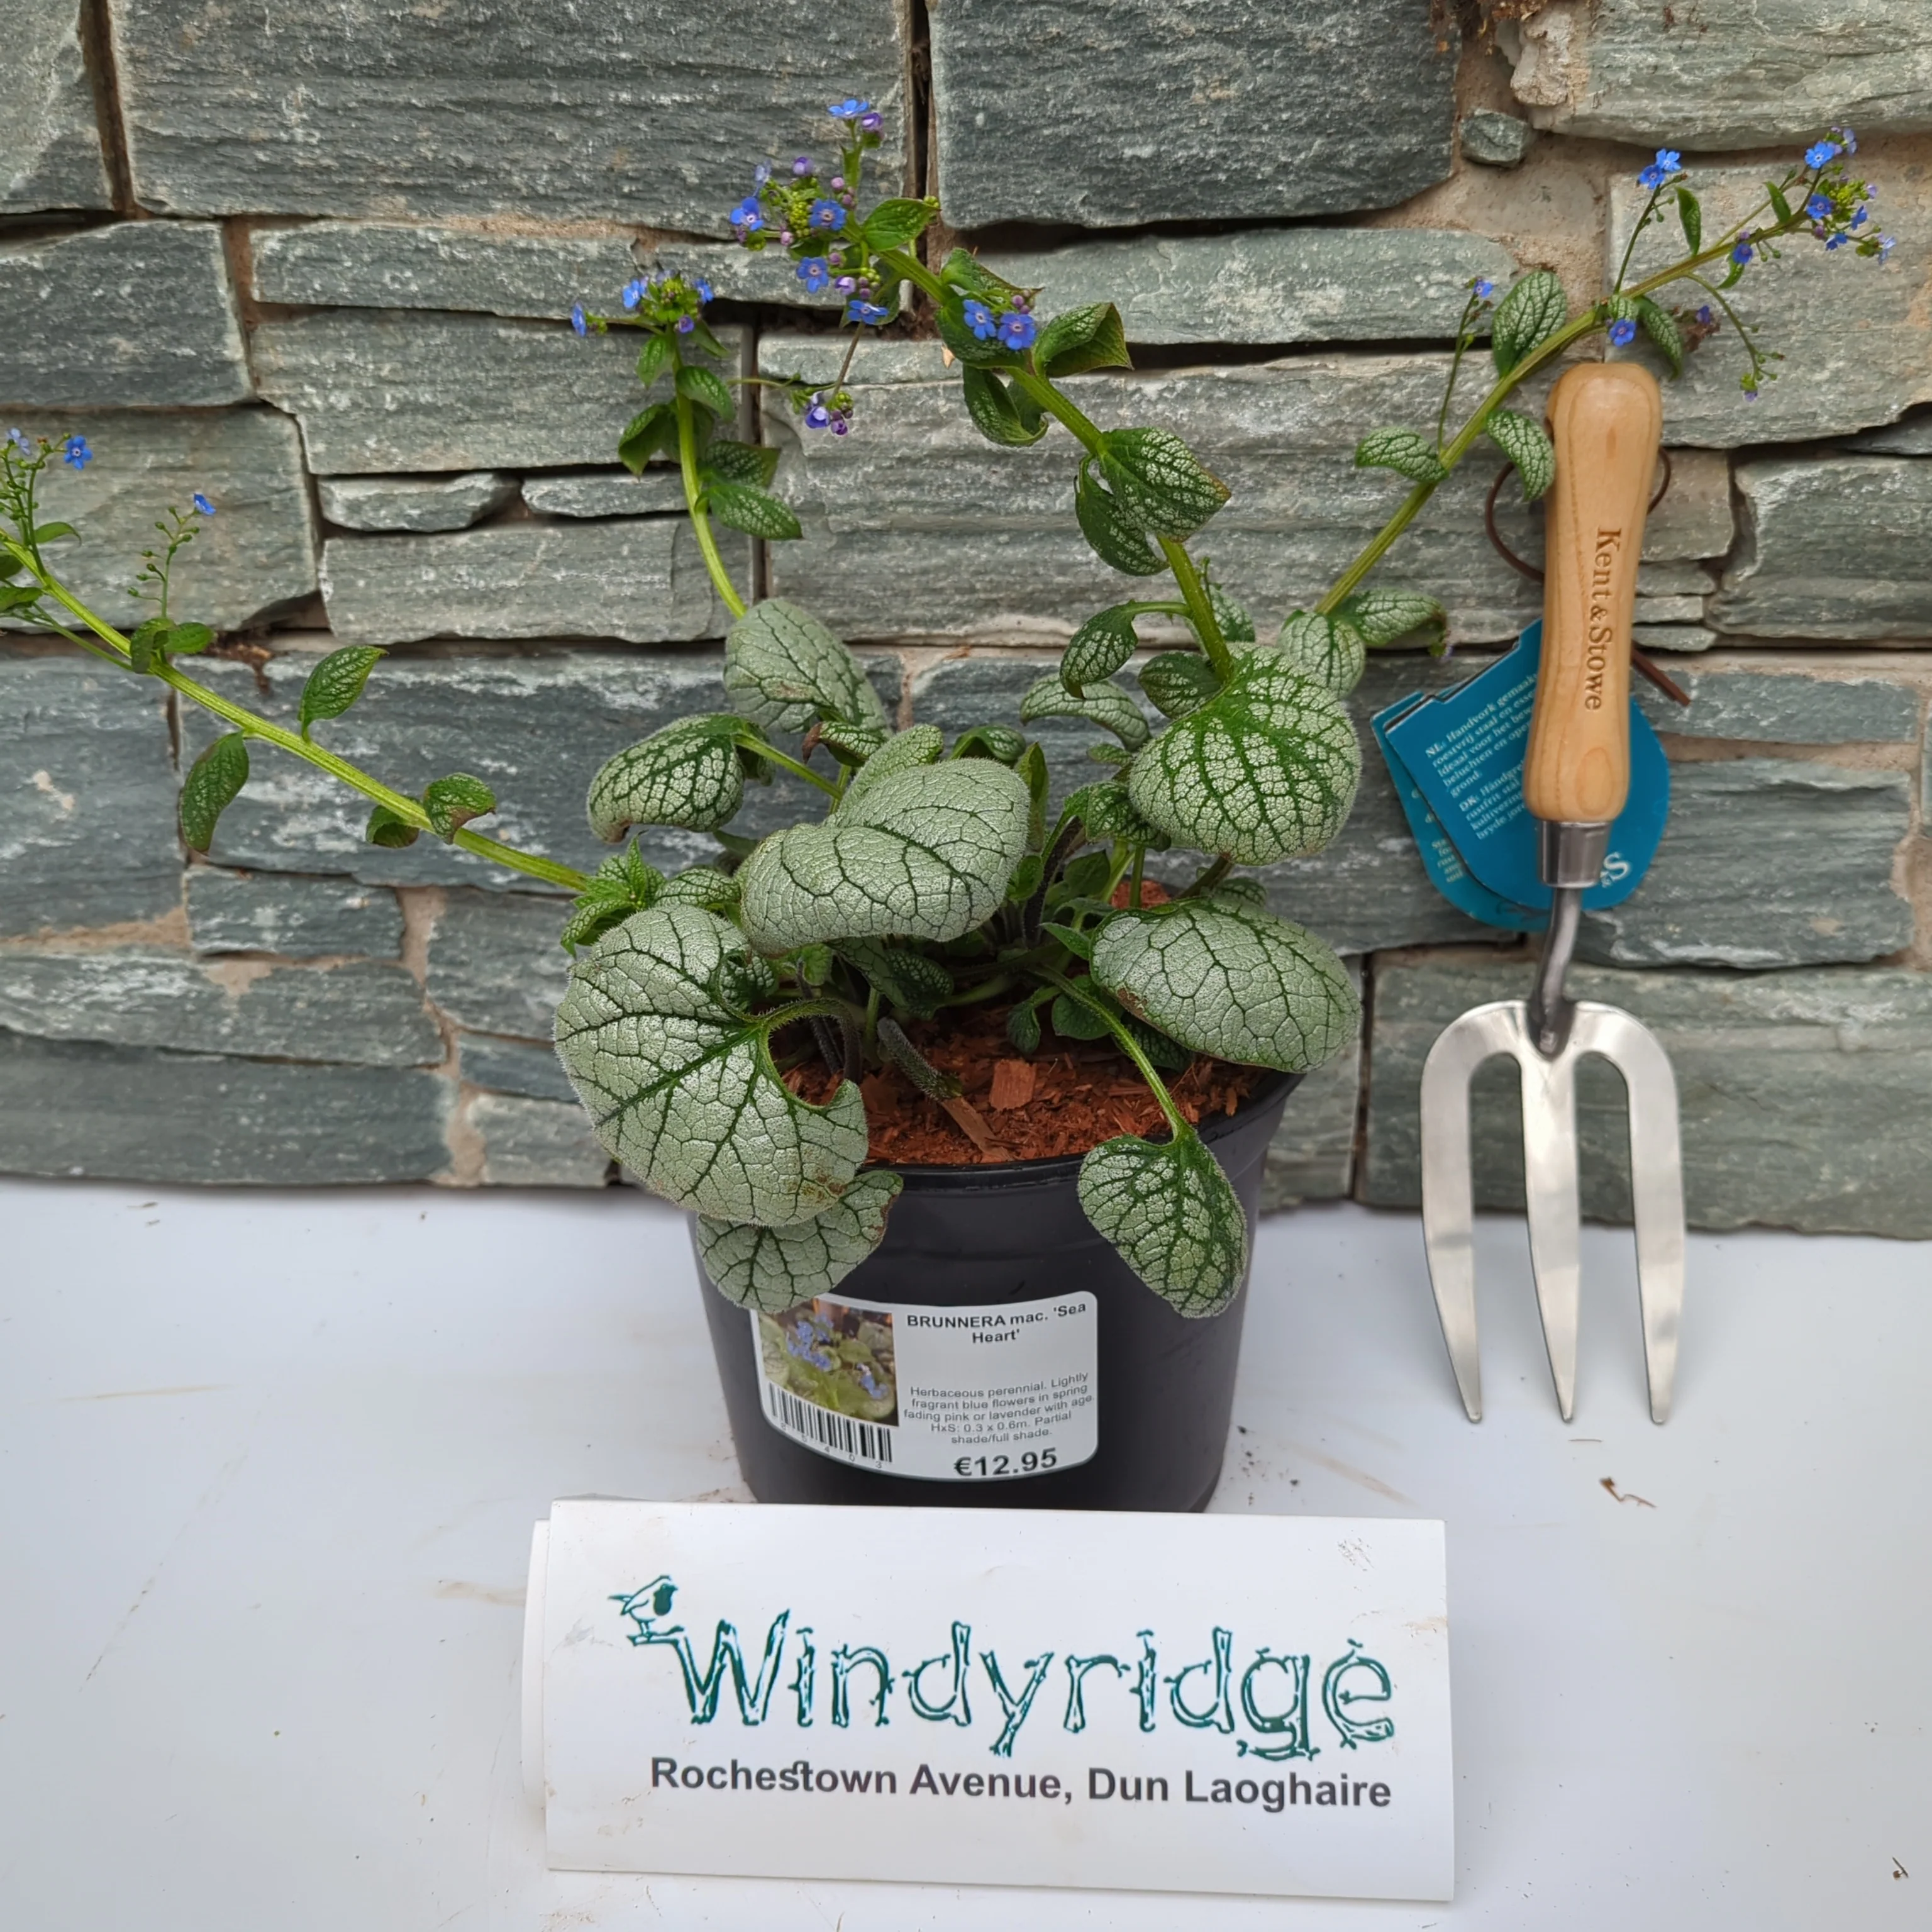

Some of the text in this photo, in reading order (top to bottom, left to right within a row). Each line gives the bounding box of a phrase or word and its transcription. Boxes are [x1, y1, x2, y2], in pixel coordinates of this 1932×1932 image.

[1591, 528, 1622, 602] Kent
[1585, 628, 1613, 711] Stowe
[1475, 715, 1498, 736] staal
[906, 1303, 1086, 1328] BRUNNERA mac. 'Sea
[972, 1329, 1020, 1343] Heart'
[910, 1372, 1089, 1398] Herbaceous perennial. Lightly
[911, 1384, 1088, 1411] fragrant blue flowers in spring
[904, 1394, 1095, 1423] fading pink or lavender with age.
[931, 1423, 960, 1433] HxS:
[963, 1423, 983, 1433] 0.3
[997, 1420, 1030, 1431] 0.6m.
[1035, 1411, 1072, 1426] Partial
[951, 1427, 1052, 1444] shade/full shade.
[953, 1447, 1057, 1476] €12.95
[626, 1609, 1395, 1760] Windyridge
[651, 1757, 1391, 1813] Rochestown Avenue, Dun Laoghaire
